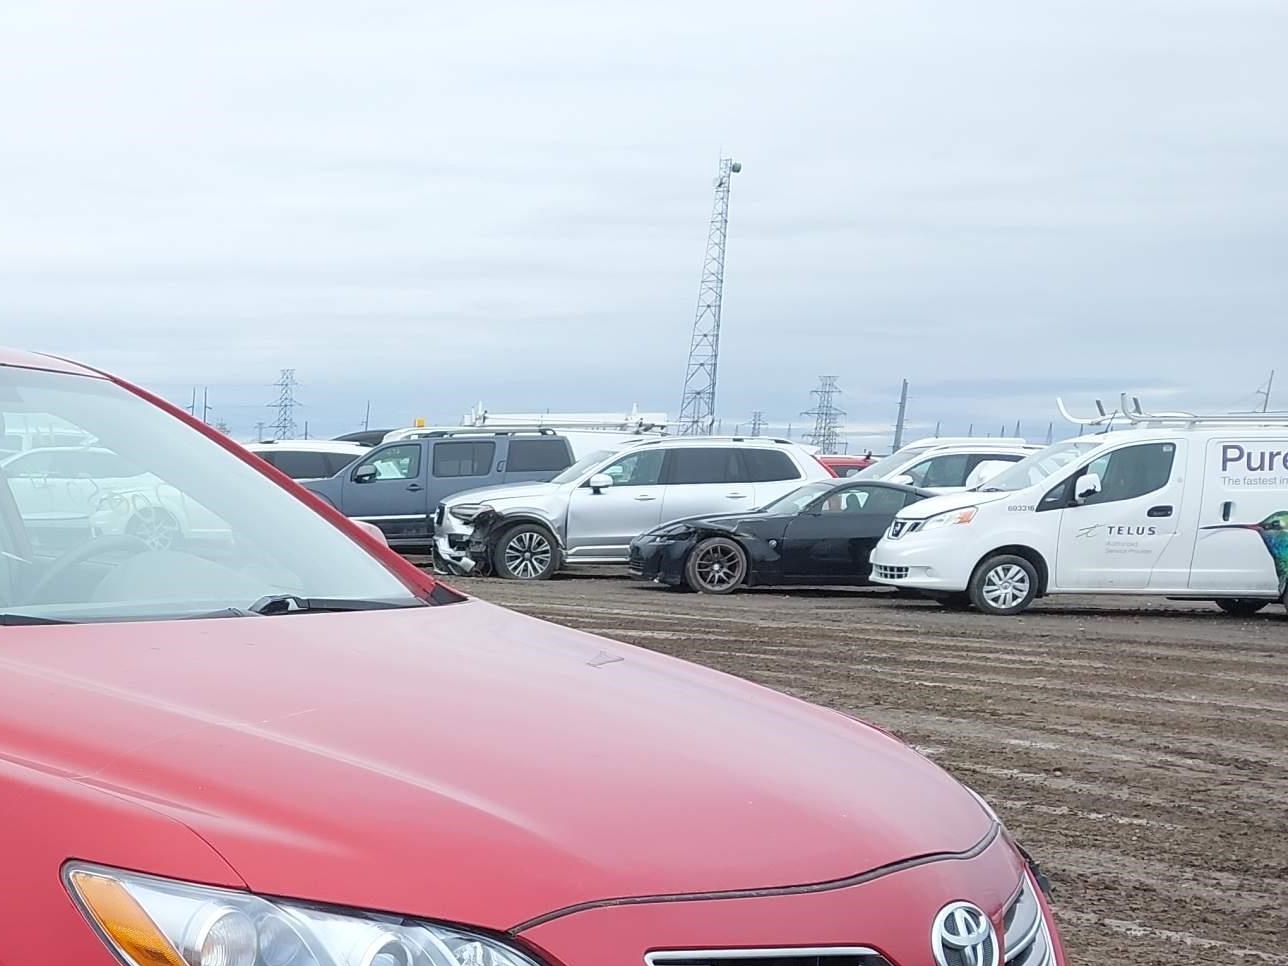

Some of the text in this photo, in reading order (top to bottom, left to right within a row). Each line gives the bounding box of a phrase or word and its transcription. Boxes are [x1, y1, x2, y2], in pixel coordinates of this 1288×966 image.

[1221, 476, 1241, 486] The
[1243, 476, 1277, 486] fastest
[1107, 526, 1157, 536] TELUS
